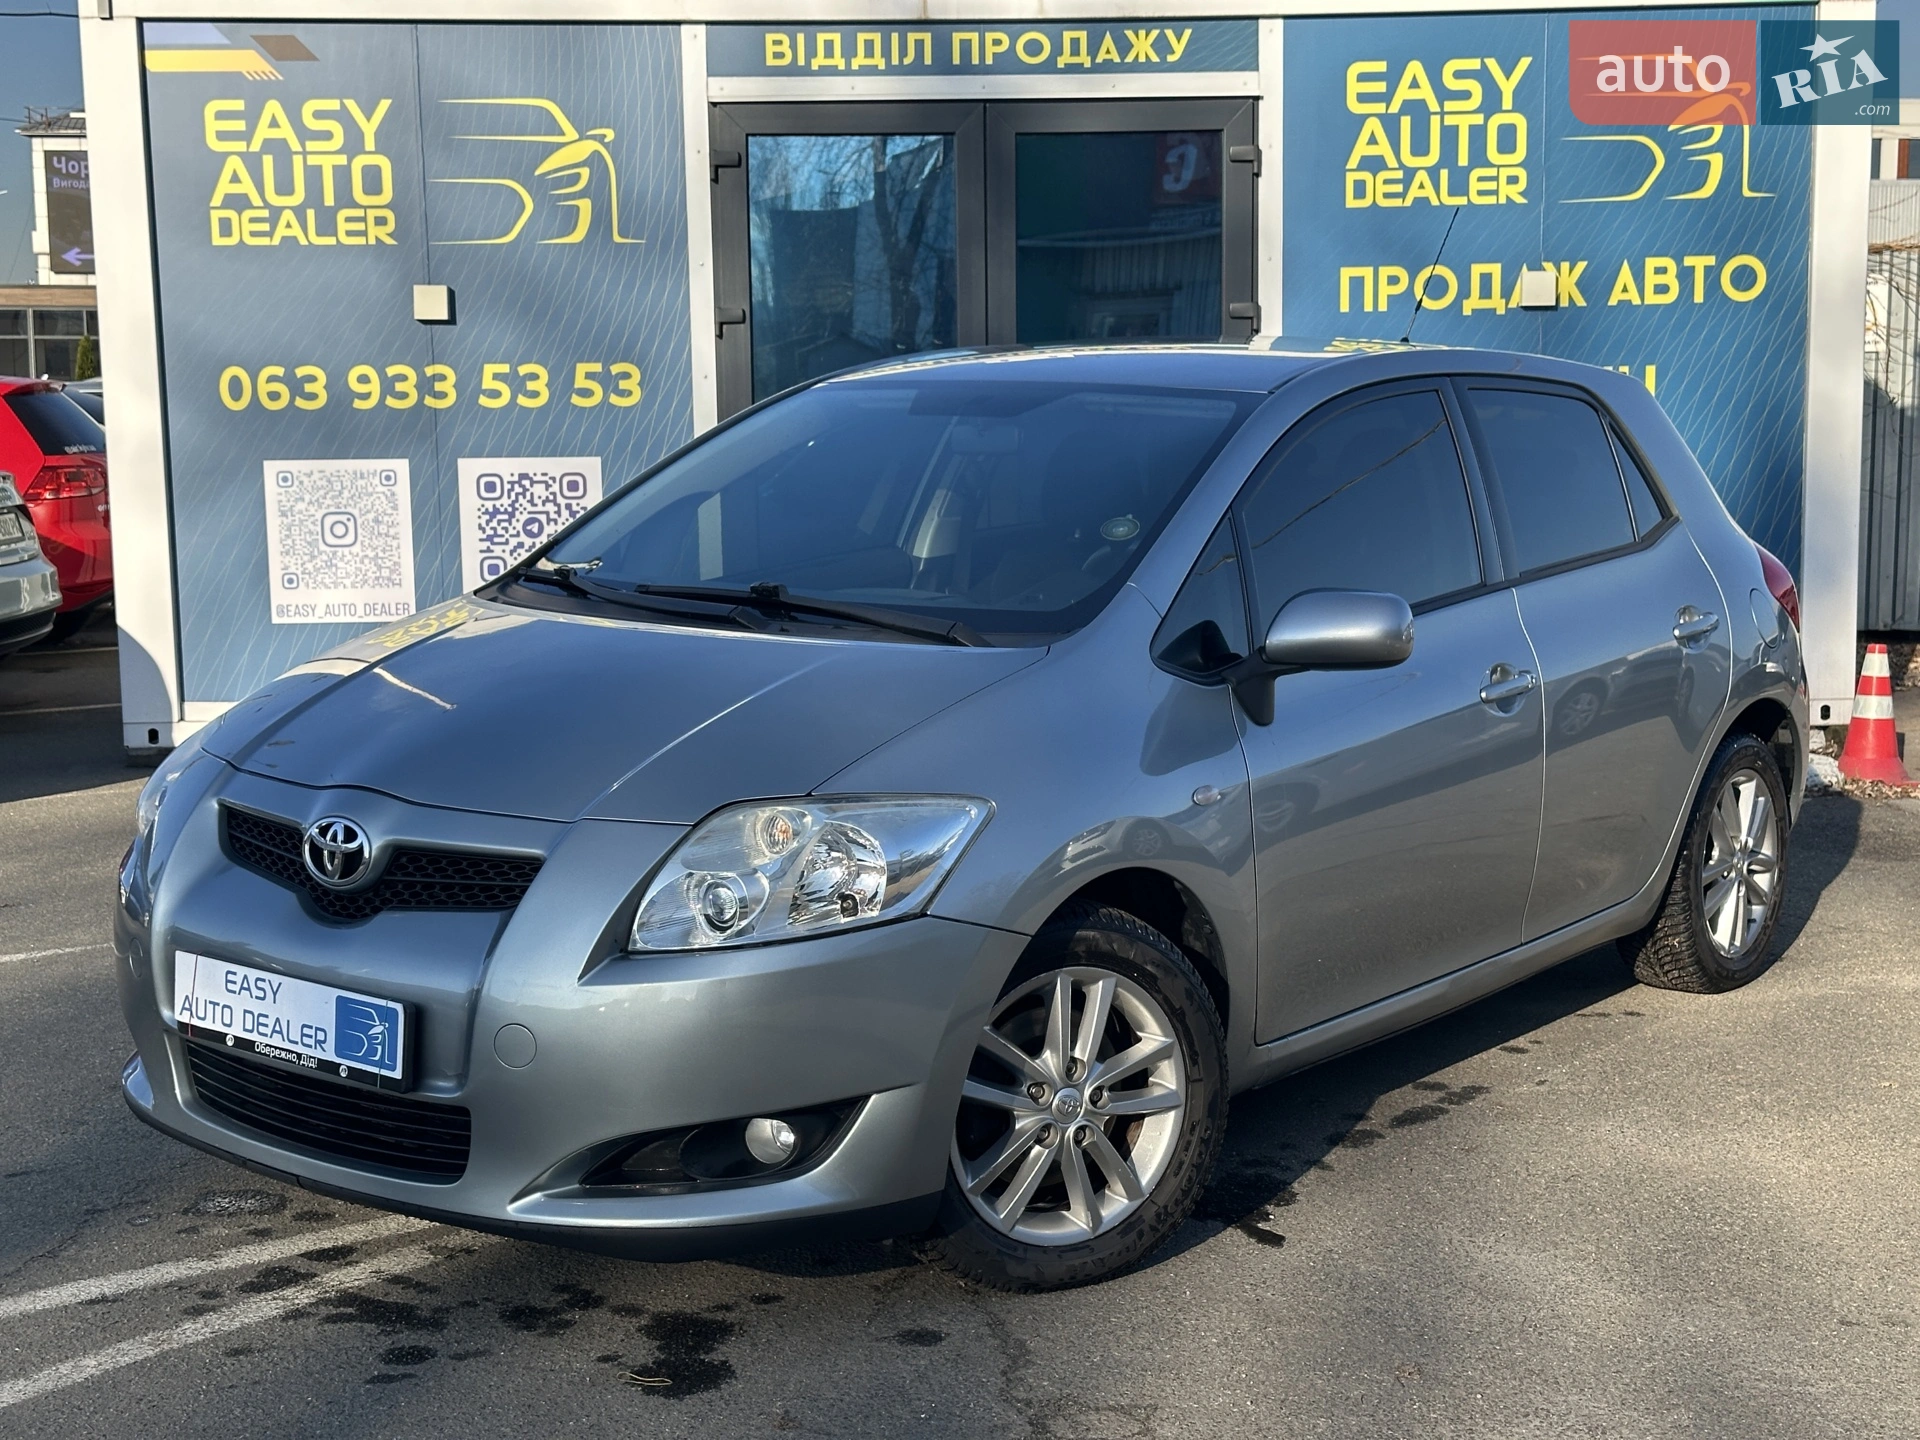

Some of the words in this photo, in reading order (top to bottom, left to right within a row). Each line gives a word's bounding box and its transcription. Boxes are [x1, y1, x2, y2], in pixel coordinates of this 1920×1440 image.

[765, 31, 932, 70] ВІДДІЛ
[952, 28, 1193, 68] ПРОДАЖУ
[1346, 56, 1533, 114] EASY
[203, 98, 393, 153] EASY
[1346, 113, 1528, 170] AUTO
[210, 154, 394, 208] AUTO
[1345, 167, 1529, 209] DEALER
[210, 207, 398, 246] DEALER
[1608, 254, 1768, 306] АВТО
[218, 364, 328, 411] 063
[347, 363, 457, 410] 933
[478, 362, 549, 409] 53
[571, 361, 642, 408] 53
[276, 602, 410, 619] @EASY_AUTO_DEALER
[224, 970, 283, 1004] EASY
[179, 995, 234, 1028] AUTO
[242, 1009, 328, 1052] DEALER
[254, 1042, 299, 1065] Обережно,
[300, 1054, 318, 1069] Дід!
